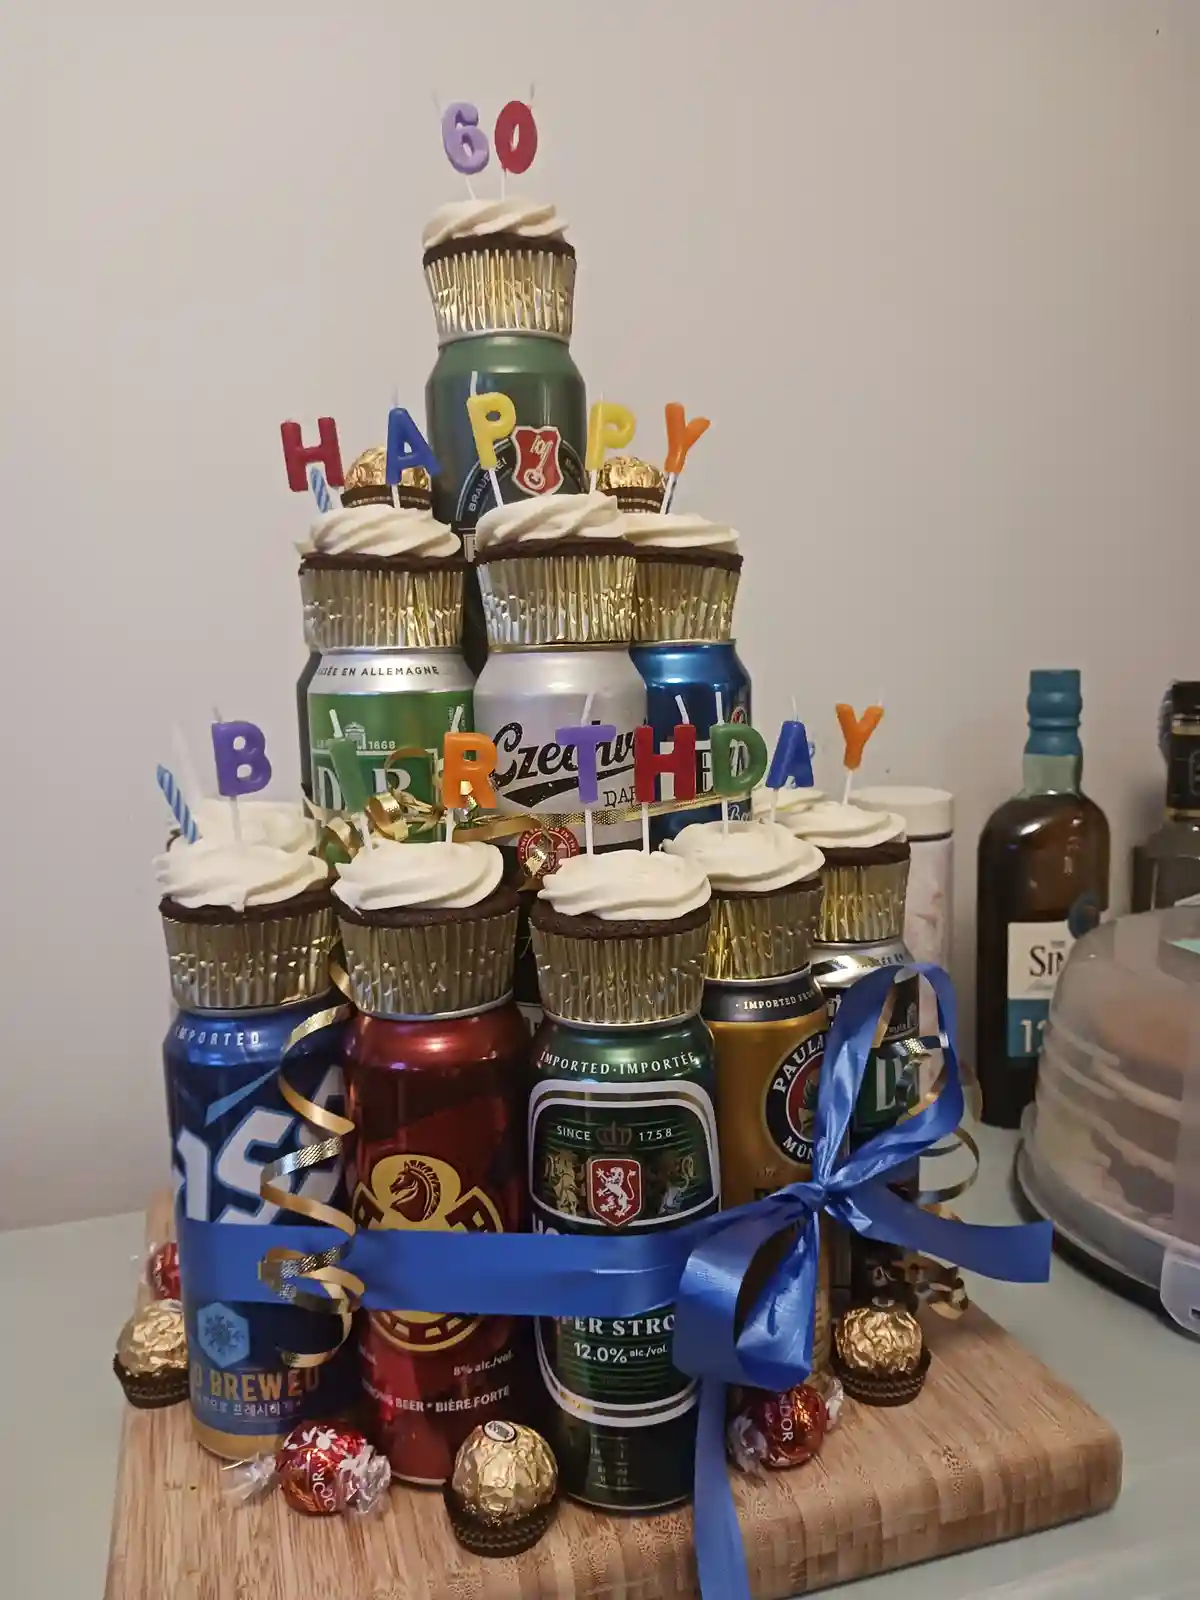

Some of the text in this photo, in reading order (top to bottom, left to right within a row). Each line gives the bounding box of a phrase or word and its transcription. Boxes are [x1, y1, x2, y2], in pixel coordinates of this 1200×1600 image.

[441, 100, 538, 175] 60
[280, 391, 711, 492] HAPPY
[468, 456, 508, 512] BRAUEEI
[341, 667, 357, 677] EN
[361, 665, 440, 677] ALLEMAGNE
[210, 702, 884, 813] BIRTHDAY
[743, 995, 797, 1010] IMPORTED
[175, 1025, 261, 1048] IMPORTED
[540, 1050, 610, 1075] IMPORTED
[772, 1034, 825, 1094] PAULA
[556, 1125, 673, 1142] SINCE 1758
[573, 1342, 628, 1364] 12.0%
[453, 1364, 474, 1376] 8%
[395, 1385, 510, 1413] BEER BIÈRE FORTE
